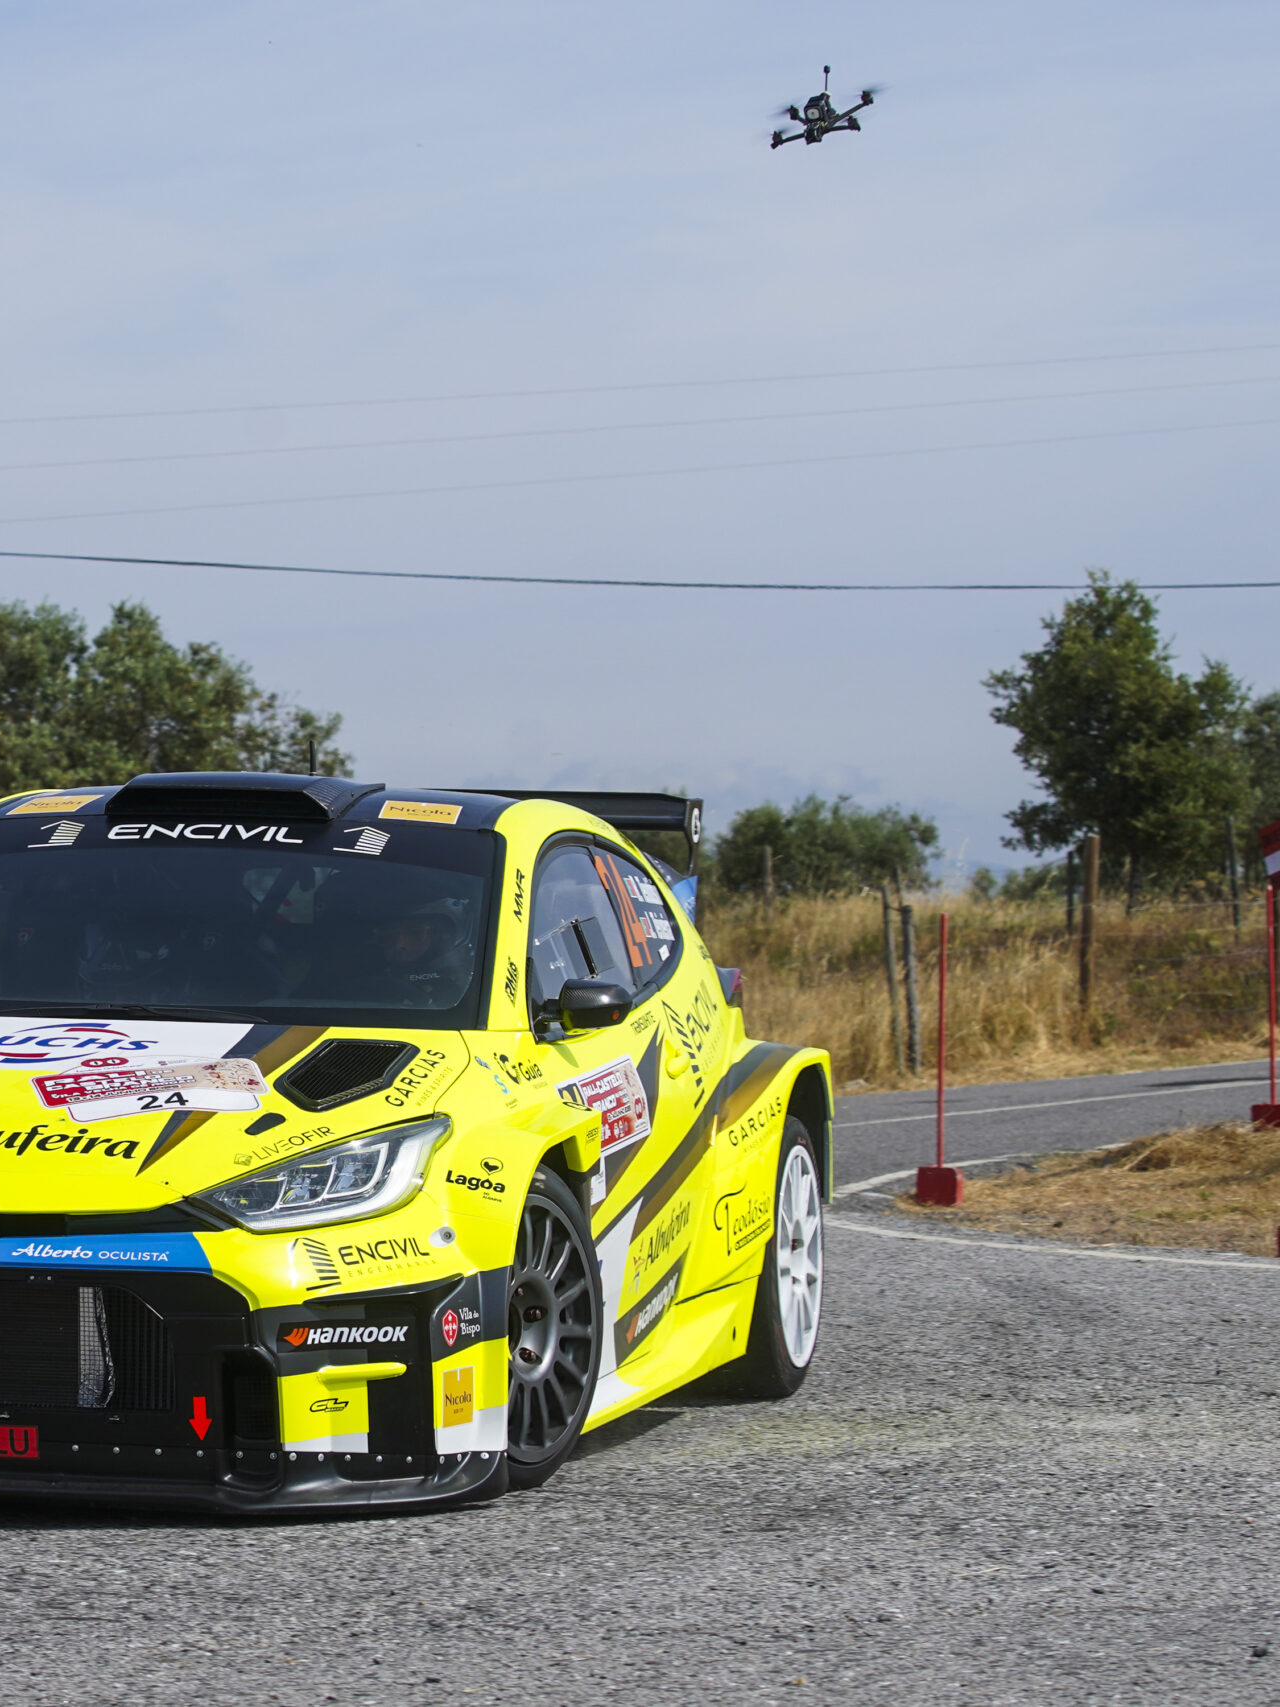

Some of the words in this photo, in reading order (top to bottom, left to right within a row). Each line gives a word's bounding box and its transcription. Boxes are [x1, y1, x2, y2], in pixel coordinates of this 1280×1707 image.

[107, 823, 304, 844] ENCIVIL
[384, 1049, 446, 1107] GARCIAS
[136, 1091, 189, 1110] 24
[728, 1096, 782, 1147] GARCIAS
[252, 1126, 335, 1160] LIVEOFIR
[445, 1169, 506, 1193] Lagoa
[12, 1242, 93, 1259] Alberto
[98, 1250, 169, 1262] OCULISTA
[338, 1237, 430, 1266] ENCIVIL
[459, 1307, 473, 1320] Vila
[460, 1322, 481, 1338] Bispo
[445, 1391, 472, 1407] Nicola
